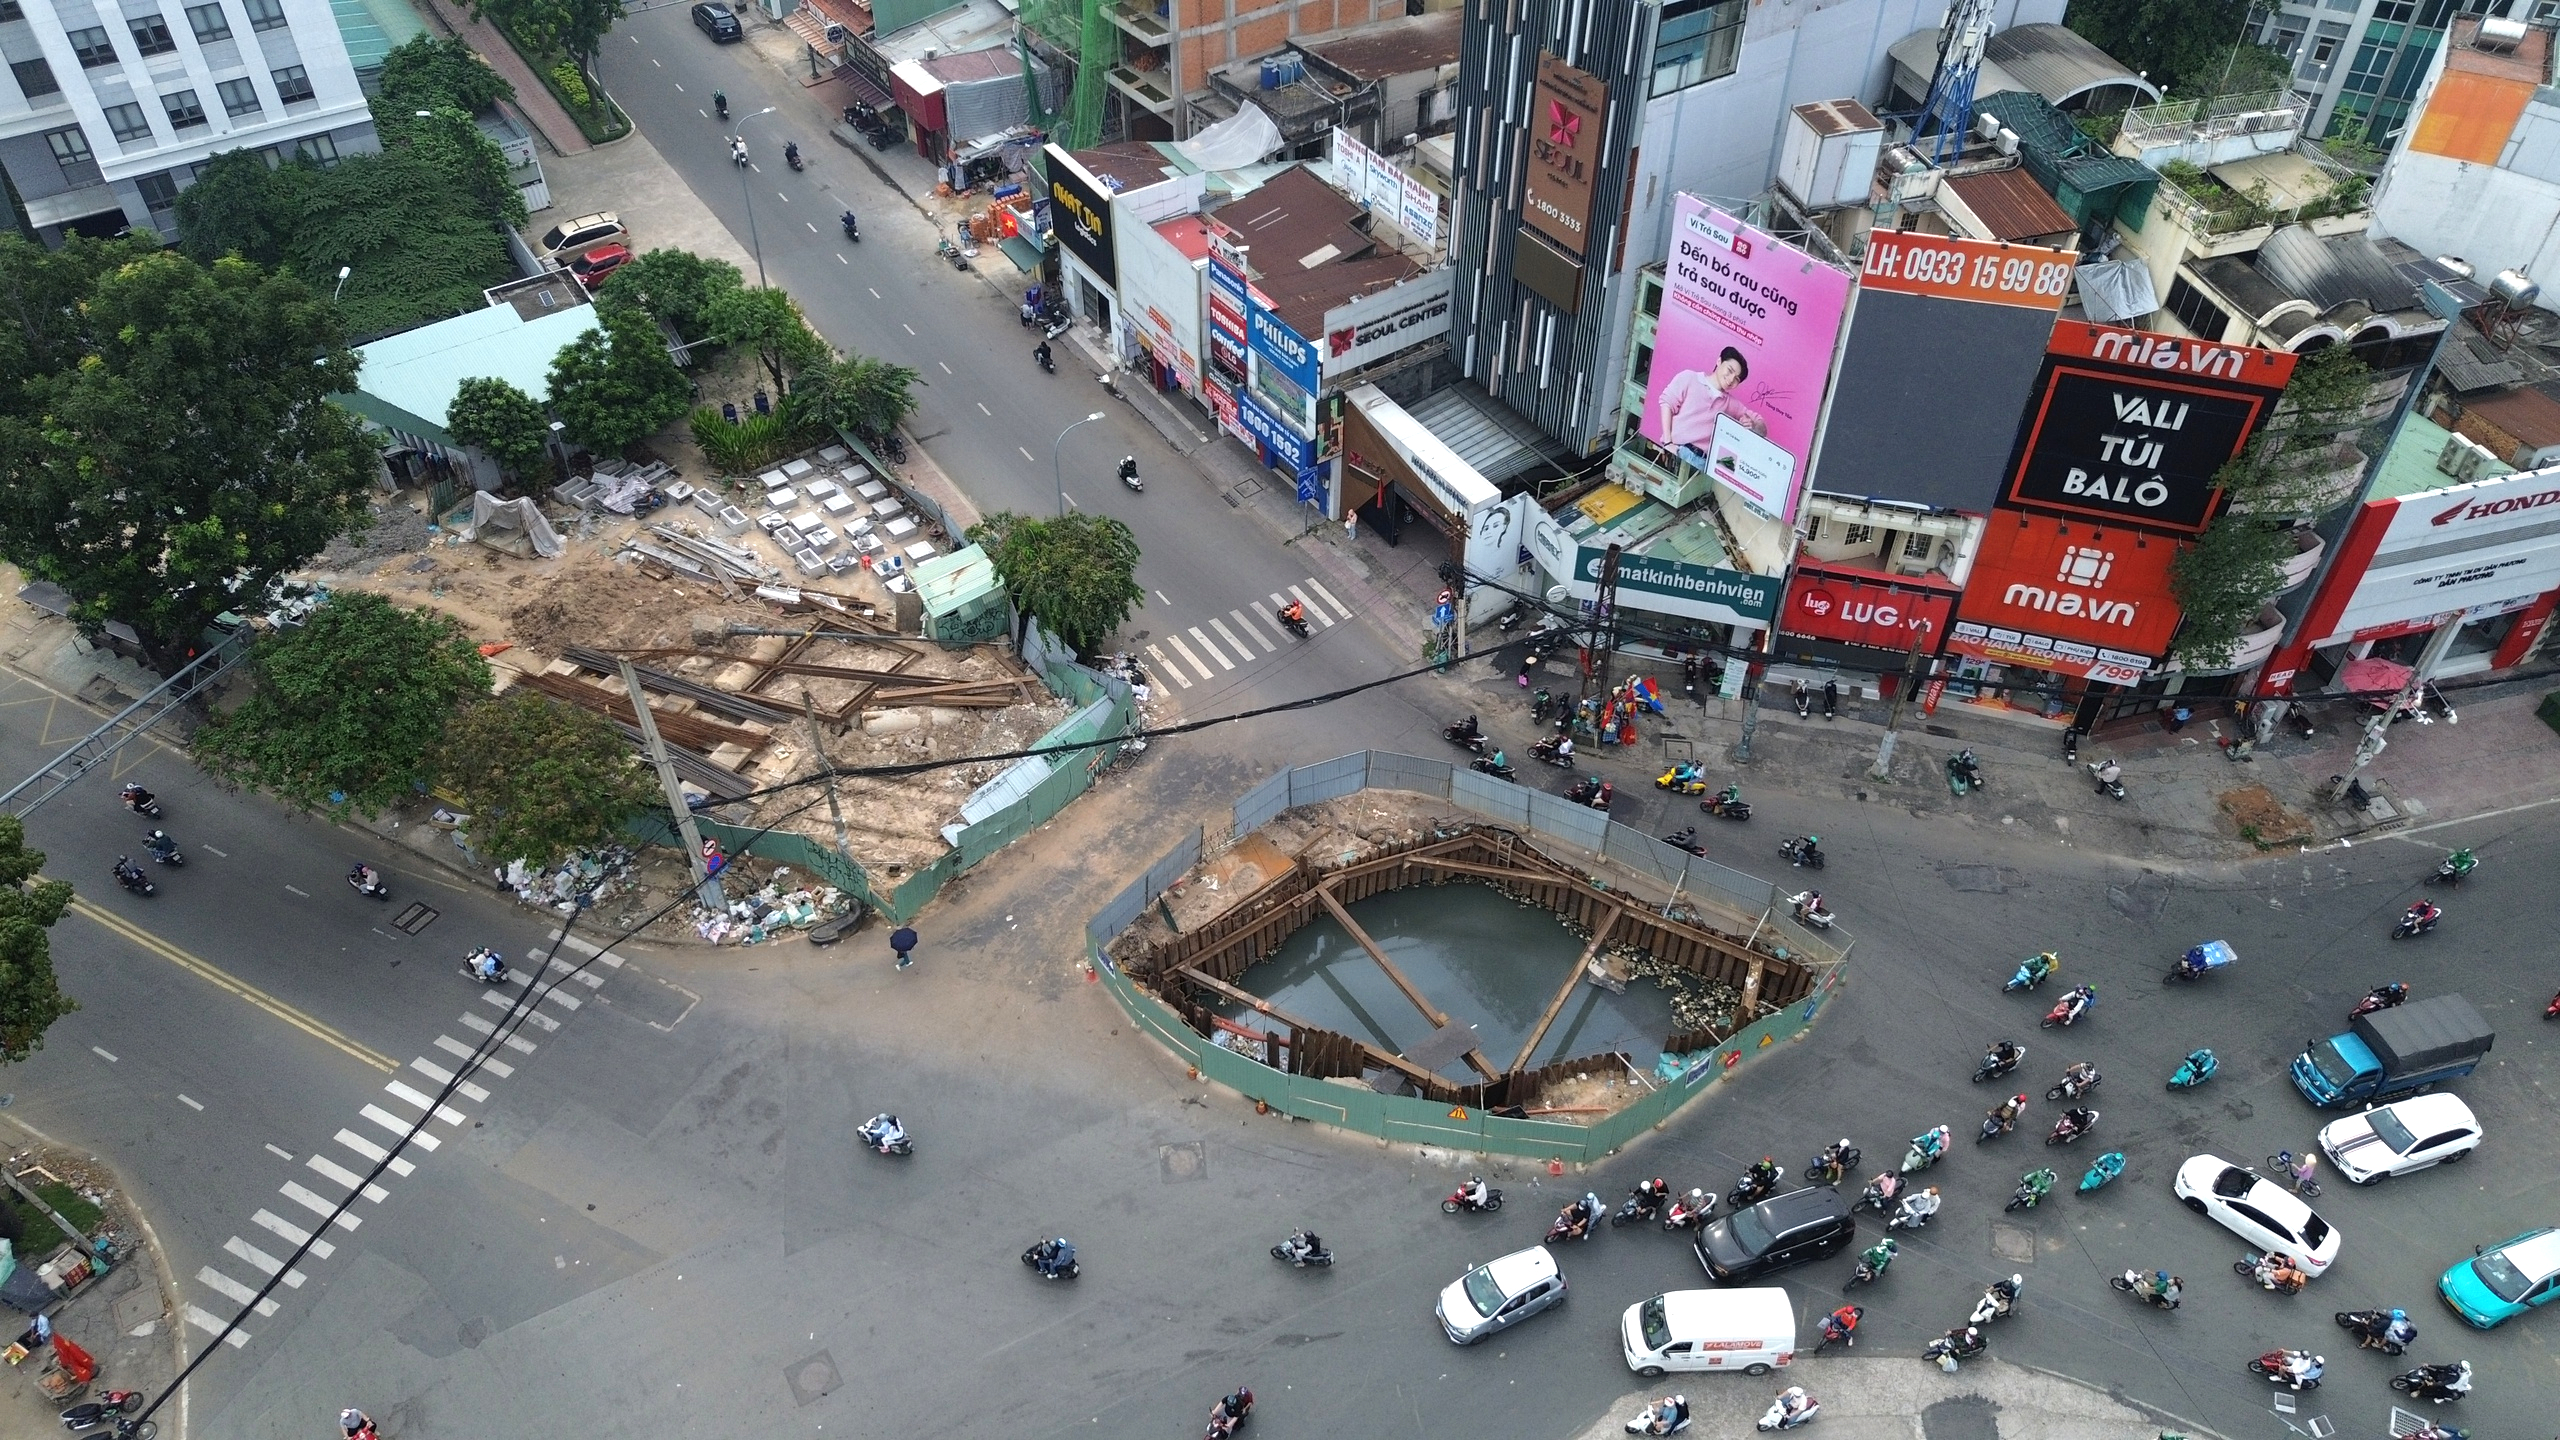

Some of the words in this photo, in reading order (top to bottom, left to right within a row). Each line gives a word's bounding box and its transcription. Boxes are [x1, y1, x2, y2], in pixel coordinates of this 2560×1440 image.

[1336, 142, 1360, 165] TOSHIA
[1534, 138, 1588, 185] SEOUL
[1404, 190, 1434, 214] SHARP
[1536, 199, 1558, 218] 1800
[1560, 212, 1582, 232] 3333
[1713, 232, 1728, 244] Sau
[1211, 263, 1244, 294] Panasonic
[1680, 240, 1708, 266] Đến
[1711, 256, 1730, 277] bó
[1733, 271, 1758, 292] rau
[1761, 286, 1798, 316] cũng
[1864, 242, 1902, 278] LH:
[1904, 247, 1965, 285] 0933
[1970, 255, 2000, 289] 15
[2000, 258, 2034, 293] 99
[2034, 262, 2070, 296] 88
[1678, 262, 1698, 283] trả
[1700, 276, 1726, 297] sau
[1729, 292, 1766, 319] được
[1211, 306, 1245, 340] TOSHIBA
[1255, 314, 1306, 365] PHILIPS
[1356, 323, 1398, 347] SEOUL
[1399, 302, 1448, 329] CENTER
[1228, 352, 1237, 365] LG
[1241, 405, 1269, 438] 1800
[2113, 392, 2190, 431] VALI
[2100, 433, 2164, 469] TÚI
[2062, 467, 2169, 507] BALÔ
[2464, 490, 2560, 520] HOND
[1616, 565, 1764, 601] matkinhbenhvien
[1740, 597, 1762, 608] .com
[1804, 593, 1830, 615] lug
[2003, 583, 2136, 627] mia.vn
[2270, 671, 2293, 680] HEAD
